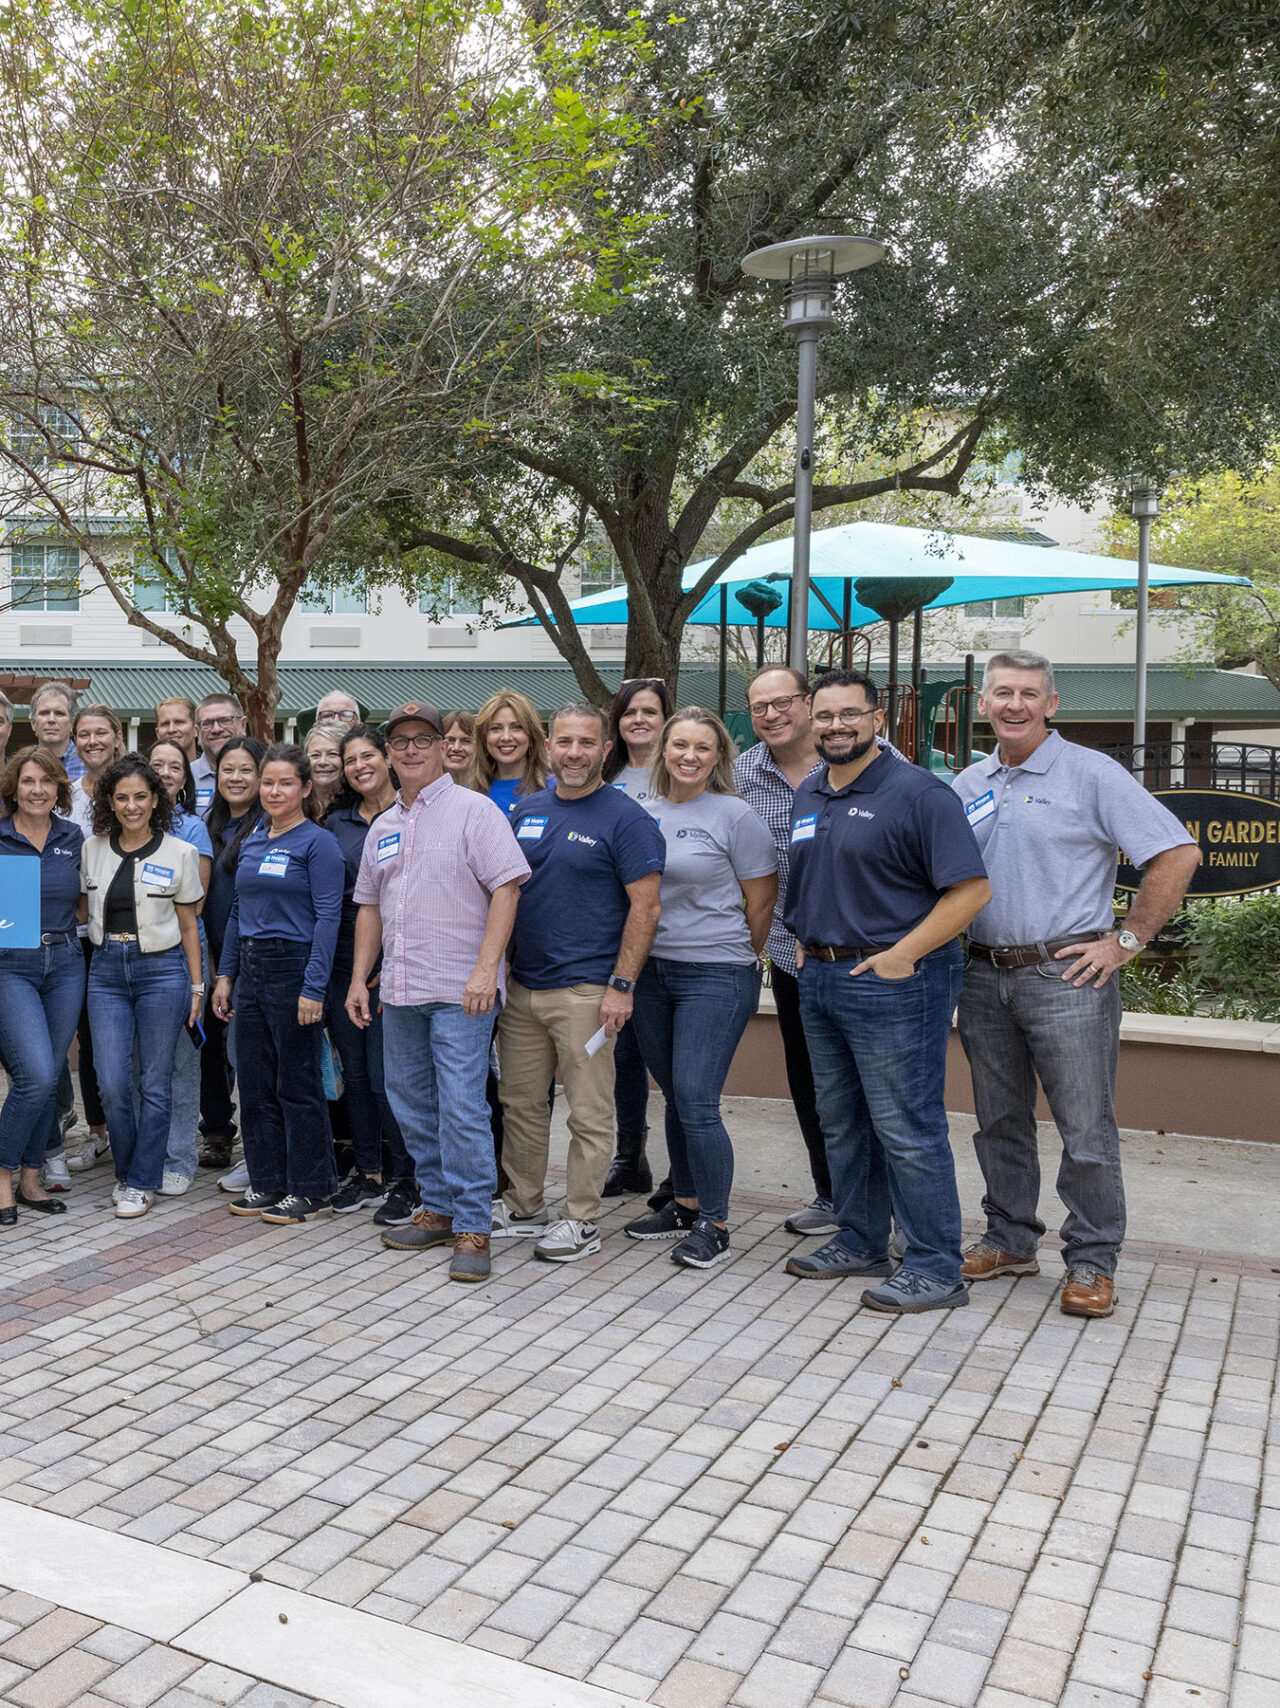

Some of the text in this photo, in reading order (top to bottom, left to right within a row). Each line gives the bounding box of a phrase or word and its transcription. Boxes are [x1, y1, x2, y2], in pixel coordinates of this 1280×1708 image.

[858, 809, 875, 820] Valley
[578, 834, 597, 847] Valley
[1210, 852, 1259, 867] FAMILY
